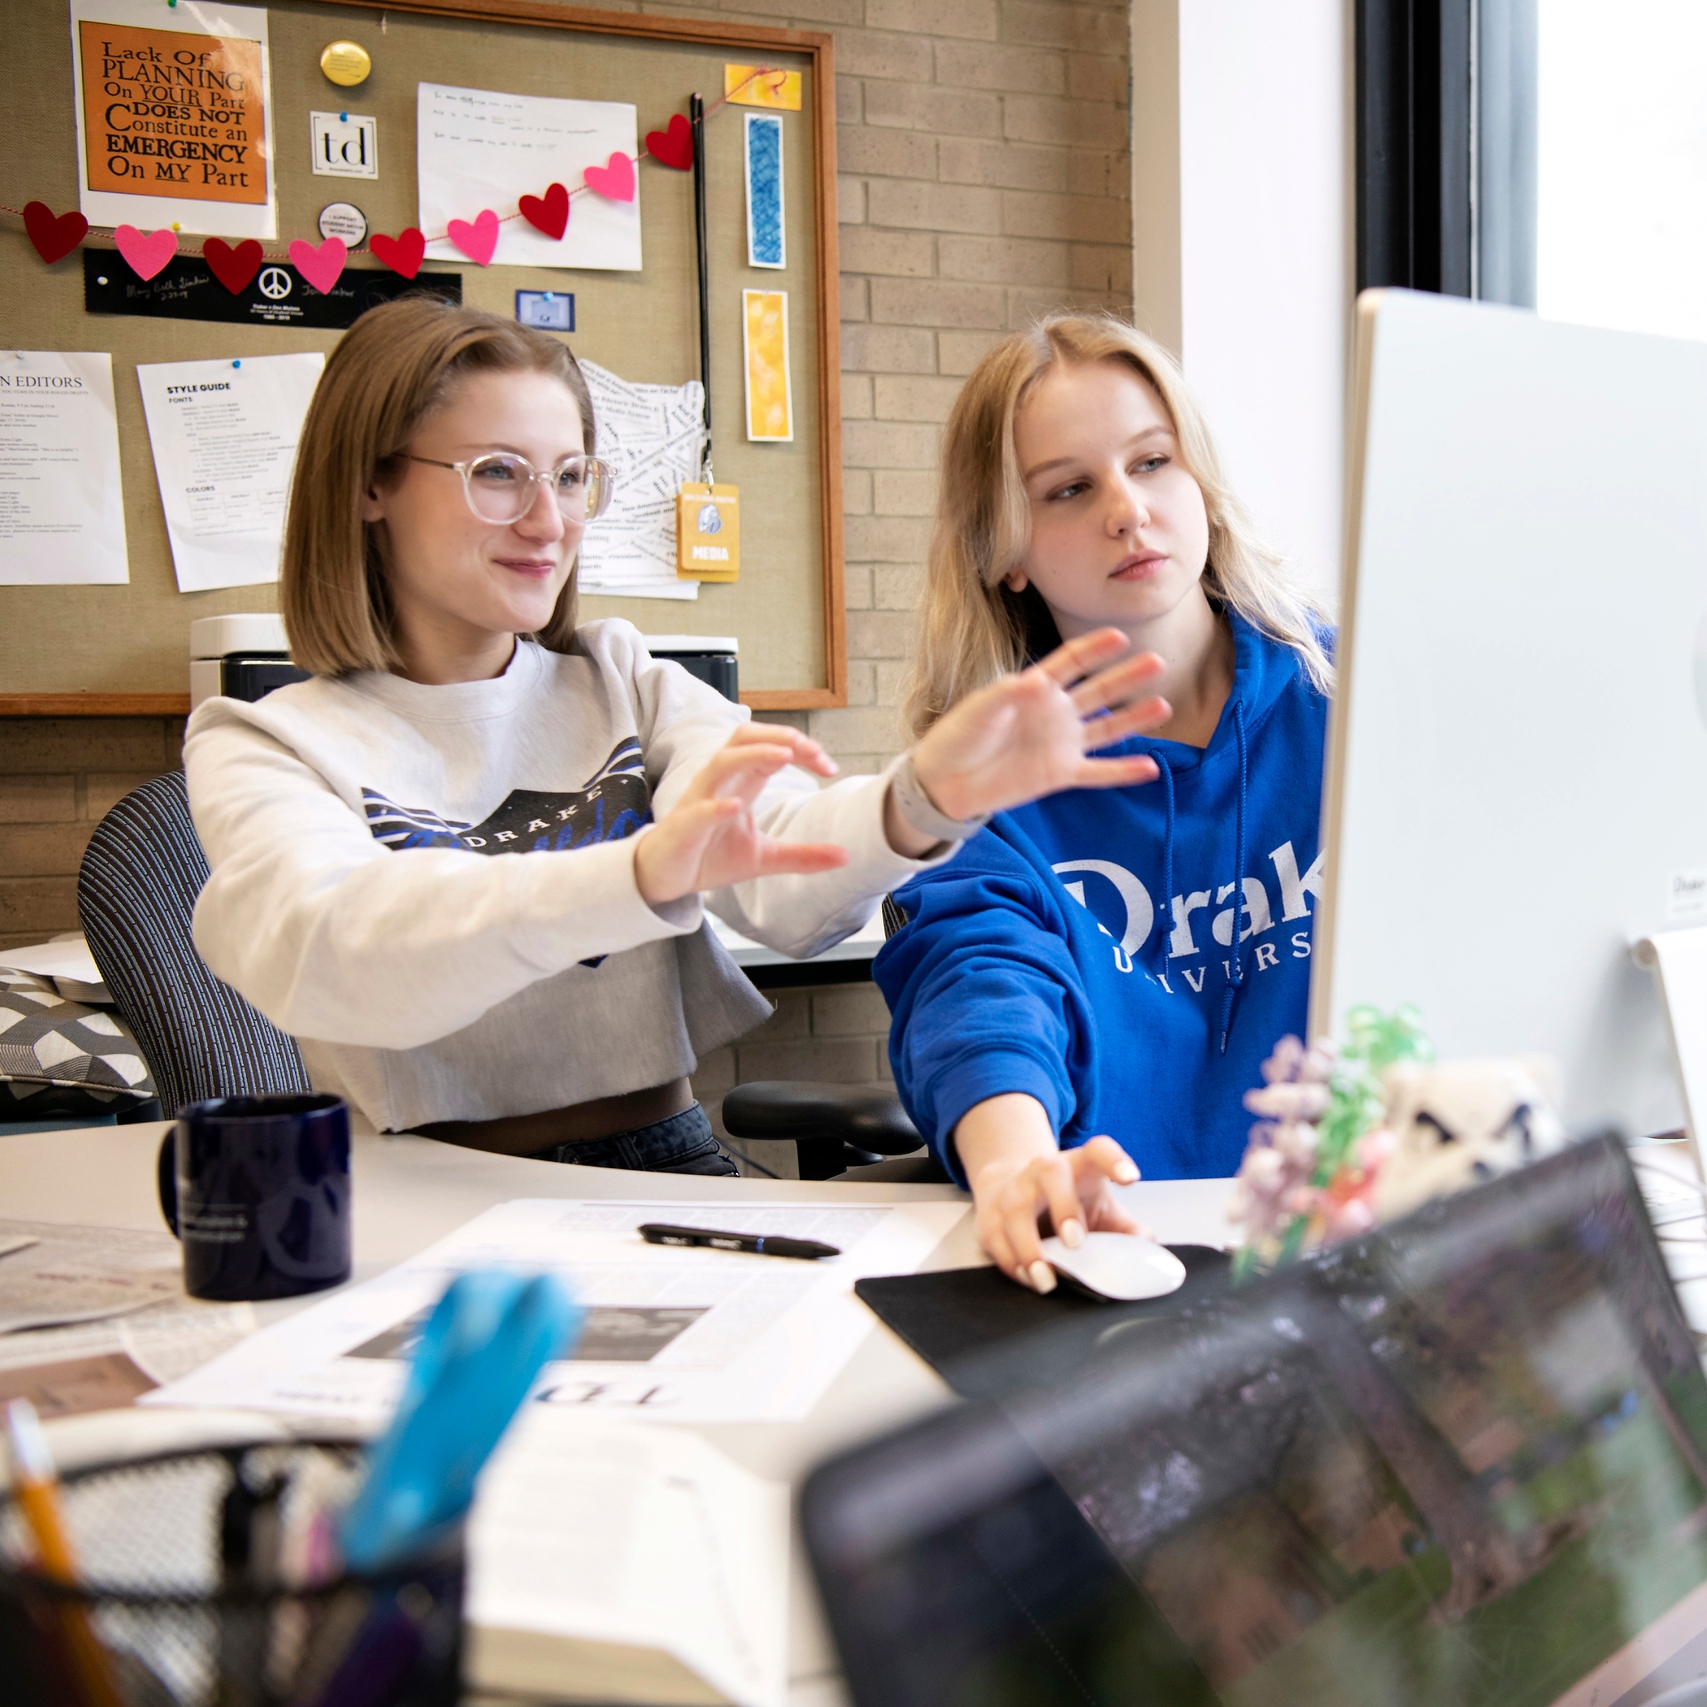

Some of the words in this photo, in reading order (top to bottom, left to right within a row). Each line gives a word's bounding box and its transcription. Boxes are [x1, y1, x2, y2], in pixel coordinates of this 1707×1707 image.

[101, 41, 163, 63] Lack
[173, 50, 211, 67] Of
[102, 58, 244, 92] PLANNING
[104, 81, 132, 99] On
[139, 84, 202, 107] YOUR
[210, 92, 245, 109] Part
[105, 103, 218, 139] Constitute
[226, 129, 248, 141] an
[132, 101, 191, 120] DOES
[199, 108, 245, 125] NOT
[106, 134, 248, 164] EMERGENCY
[320, 126, 370, 166] td
[107, 155, 145, 179] On
[155, 162, 192, 182] MY
[202, 163, 249, 188] Part
[16, 376, 83, 388] EDITORS
[167, 384, 198, 394] STYLE
[199, 382, 231, 392] GUIDE
[185, 485, 216, 494] COLORS
[692, 545, 730, 561] MEDIA
[463, 785, 603, 848] DRAKE
[1111, 931, 1312, 995] UIVERS
